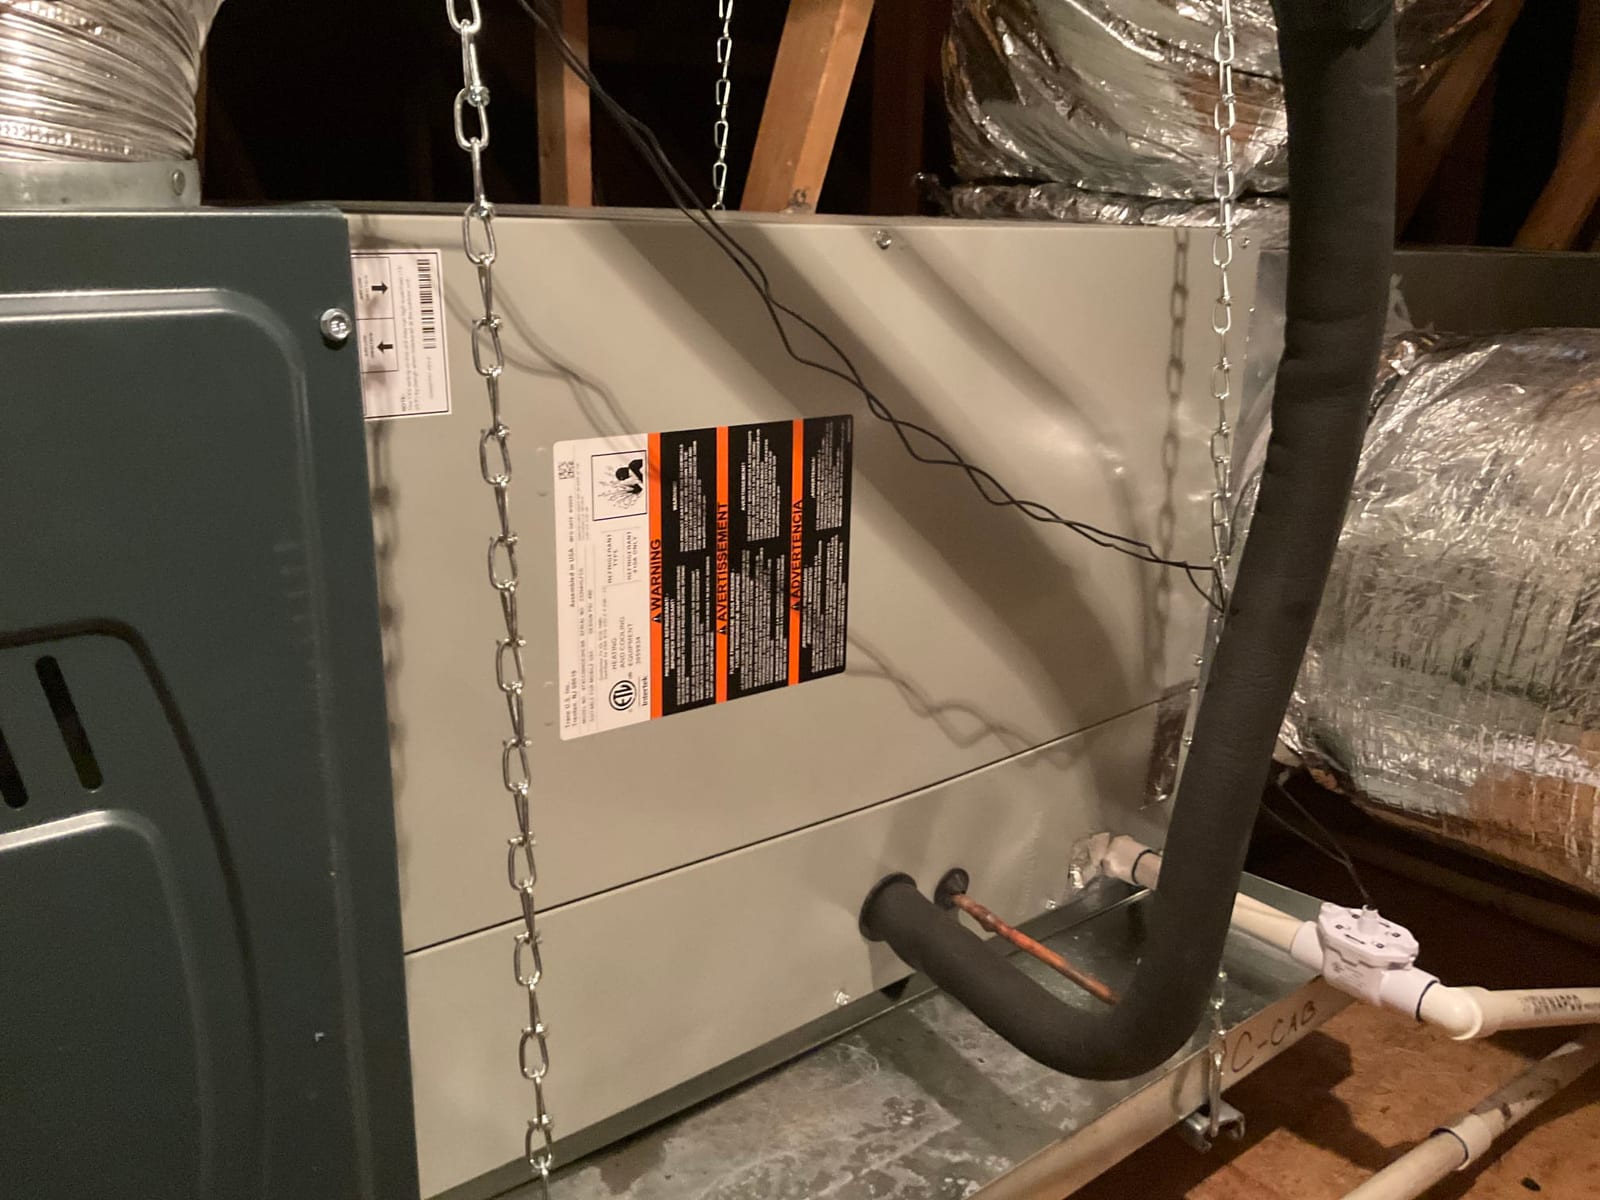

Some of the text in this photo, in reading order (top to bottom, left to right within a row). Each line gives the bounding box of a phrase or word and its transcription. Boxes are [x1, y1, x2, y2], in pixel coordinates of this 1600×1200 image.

[650, 539, 661, 611] WARNING
[717, 502, 728, 622] AVERTISSEMENT
[791, 499, 802, 599] ADVERTENCIA
[571, 691, 577, 699] NJ
